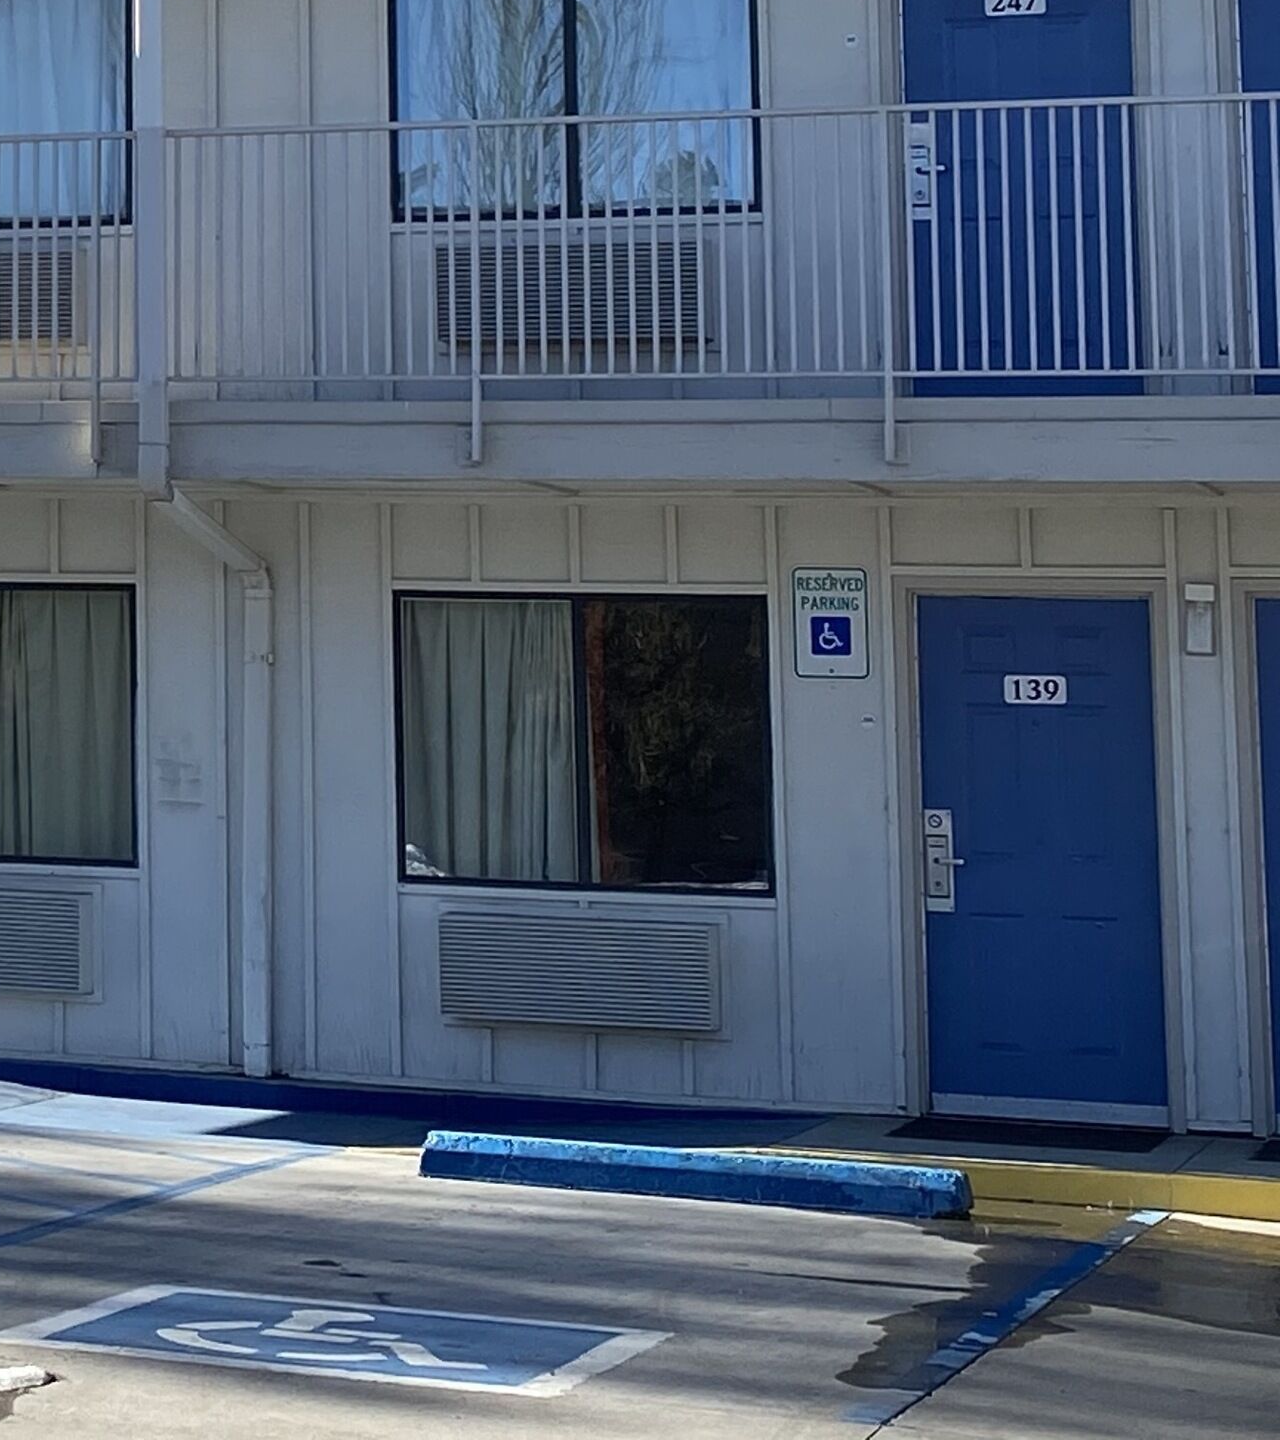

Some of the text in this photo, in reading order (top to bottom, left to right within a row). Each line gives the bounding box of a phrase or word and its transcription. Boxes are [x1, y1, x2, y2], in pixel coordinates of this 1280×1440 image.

[796, 576, 864, 592] RESERVED
[801, 596, 860, 611] PARKING
[1012, 679, 1060, 701] 139
